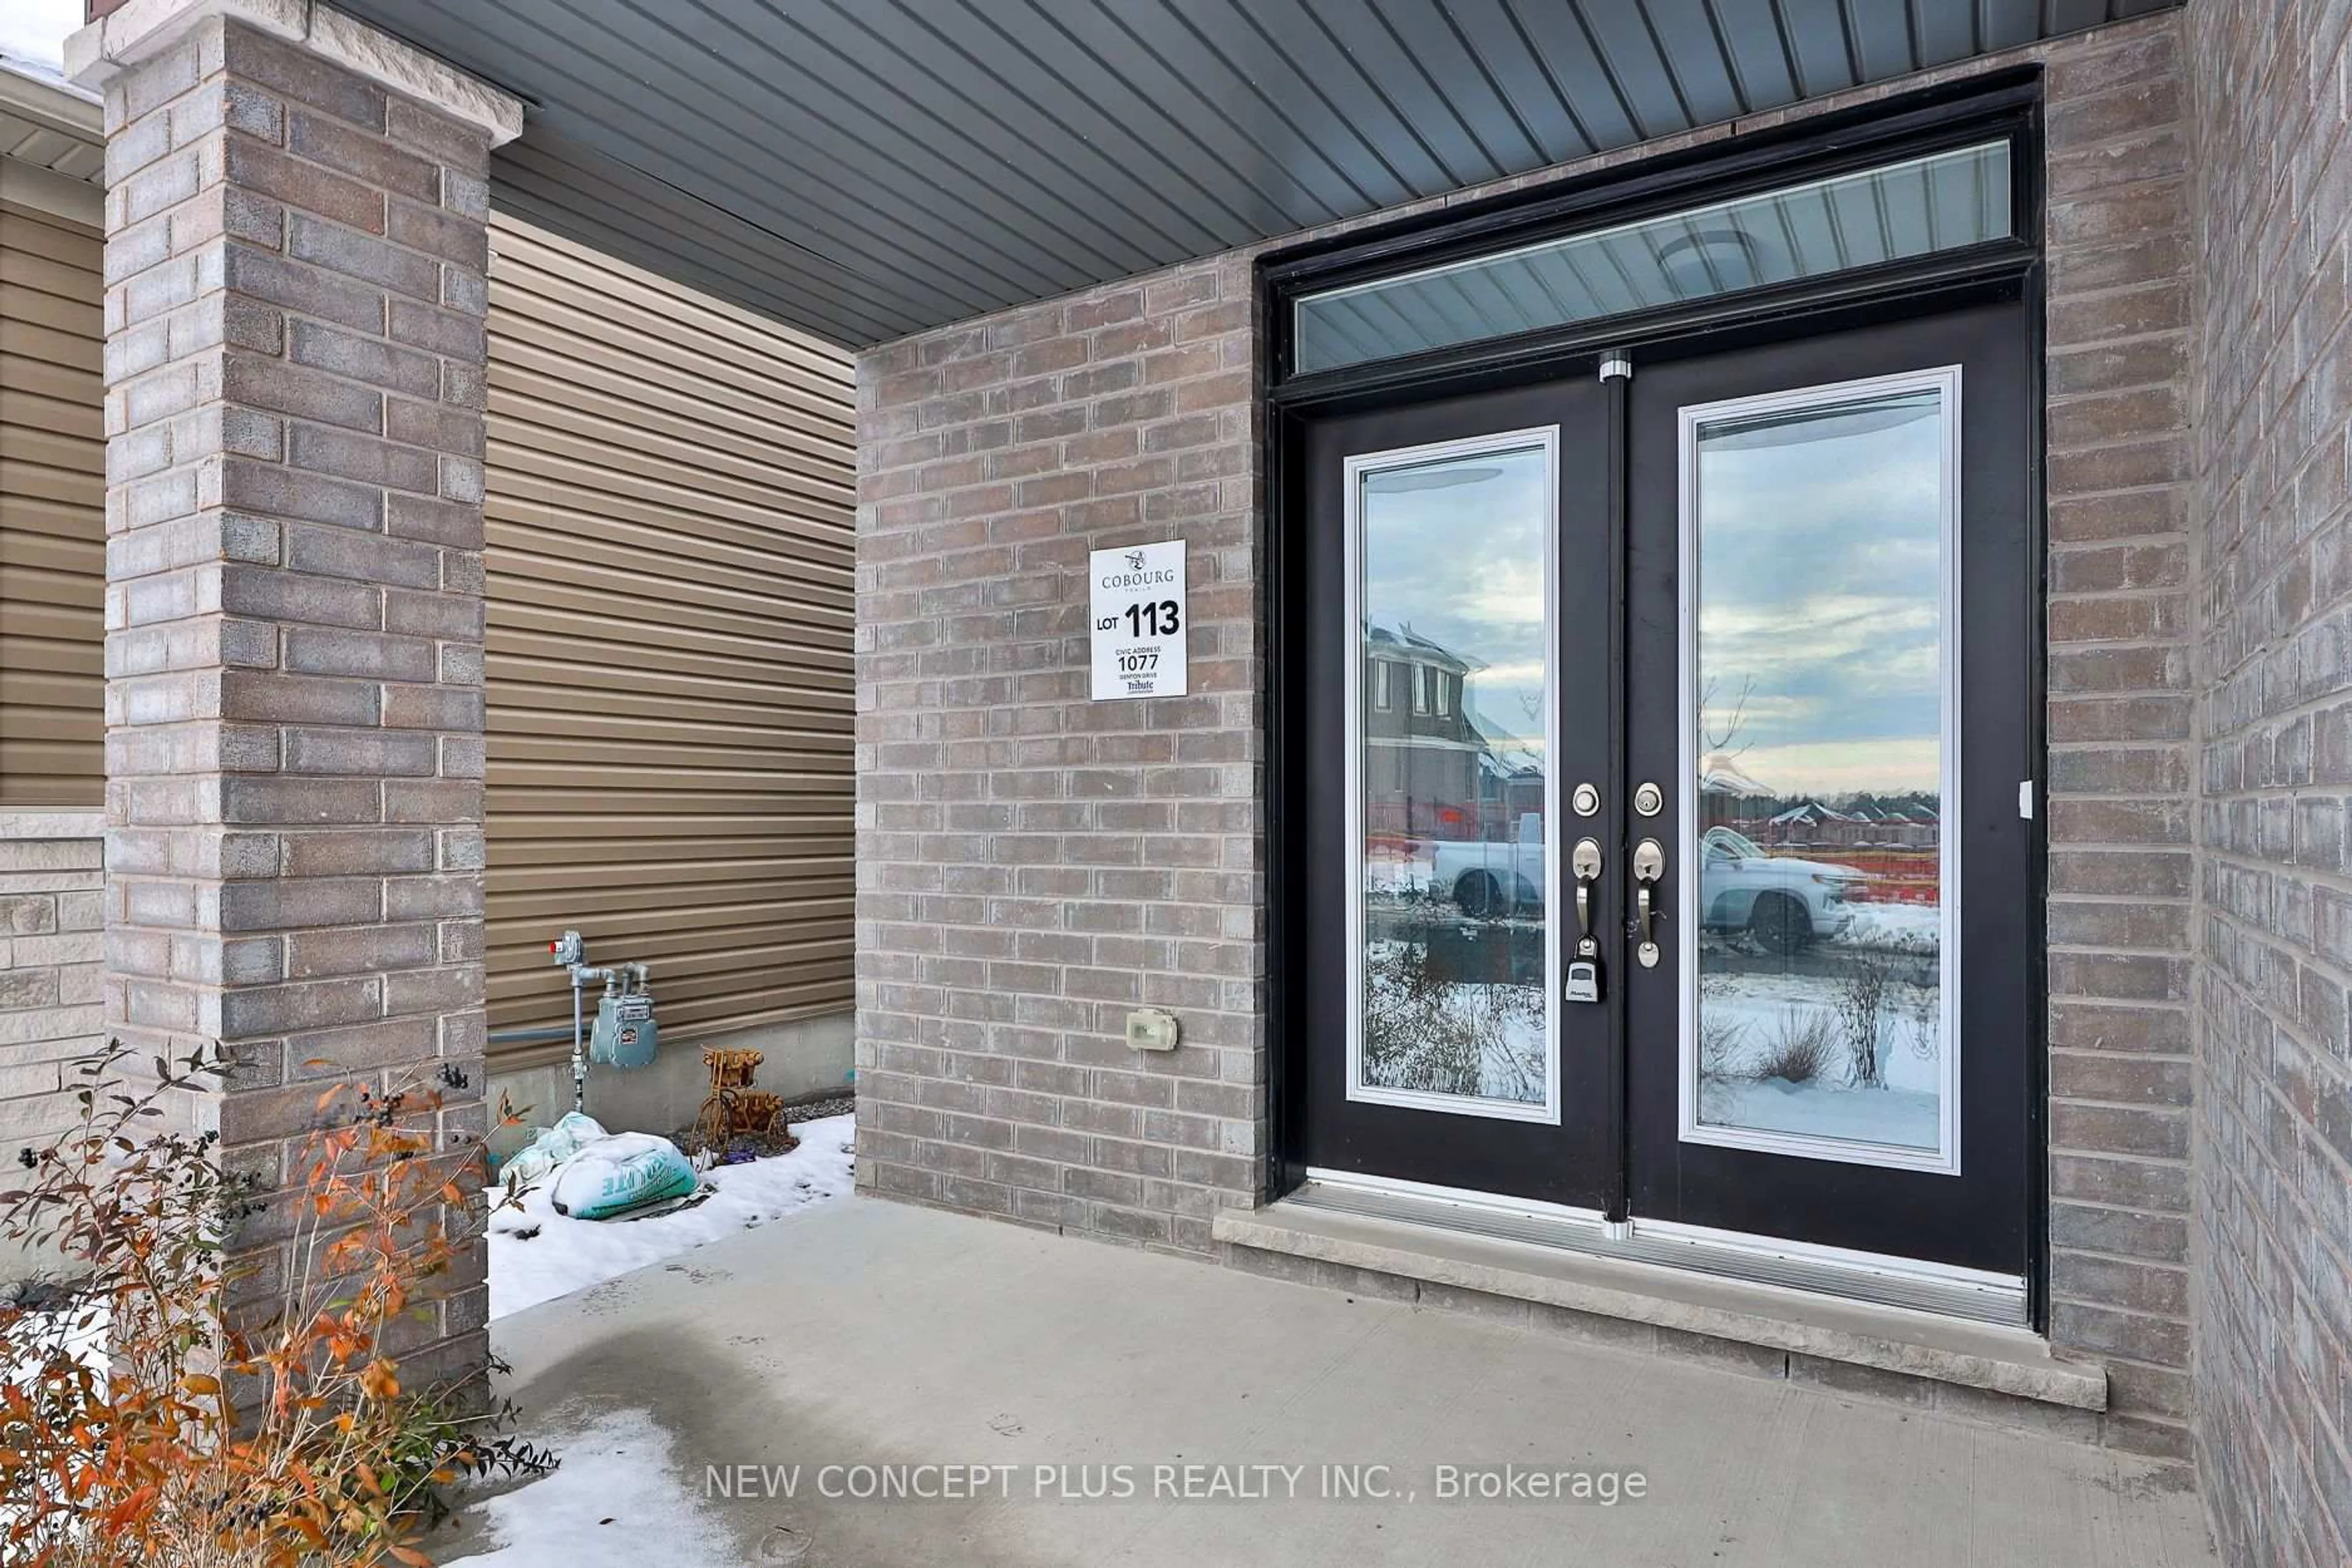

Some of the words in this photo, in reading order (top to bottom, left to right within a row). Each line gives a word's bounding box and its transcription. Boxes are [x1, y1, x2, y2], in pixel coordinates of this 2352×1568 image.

[1102, 569, 1174, 589] COBOURG
[1097, 617, 1119, 630] LOT
[1125, 600, 1180, 638] 113
[1133, 646, 1161, 654] ADDRESS
[1118, 654, 1159, 672] 1077
